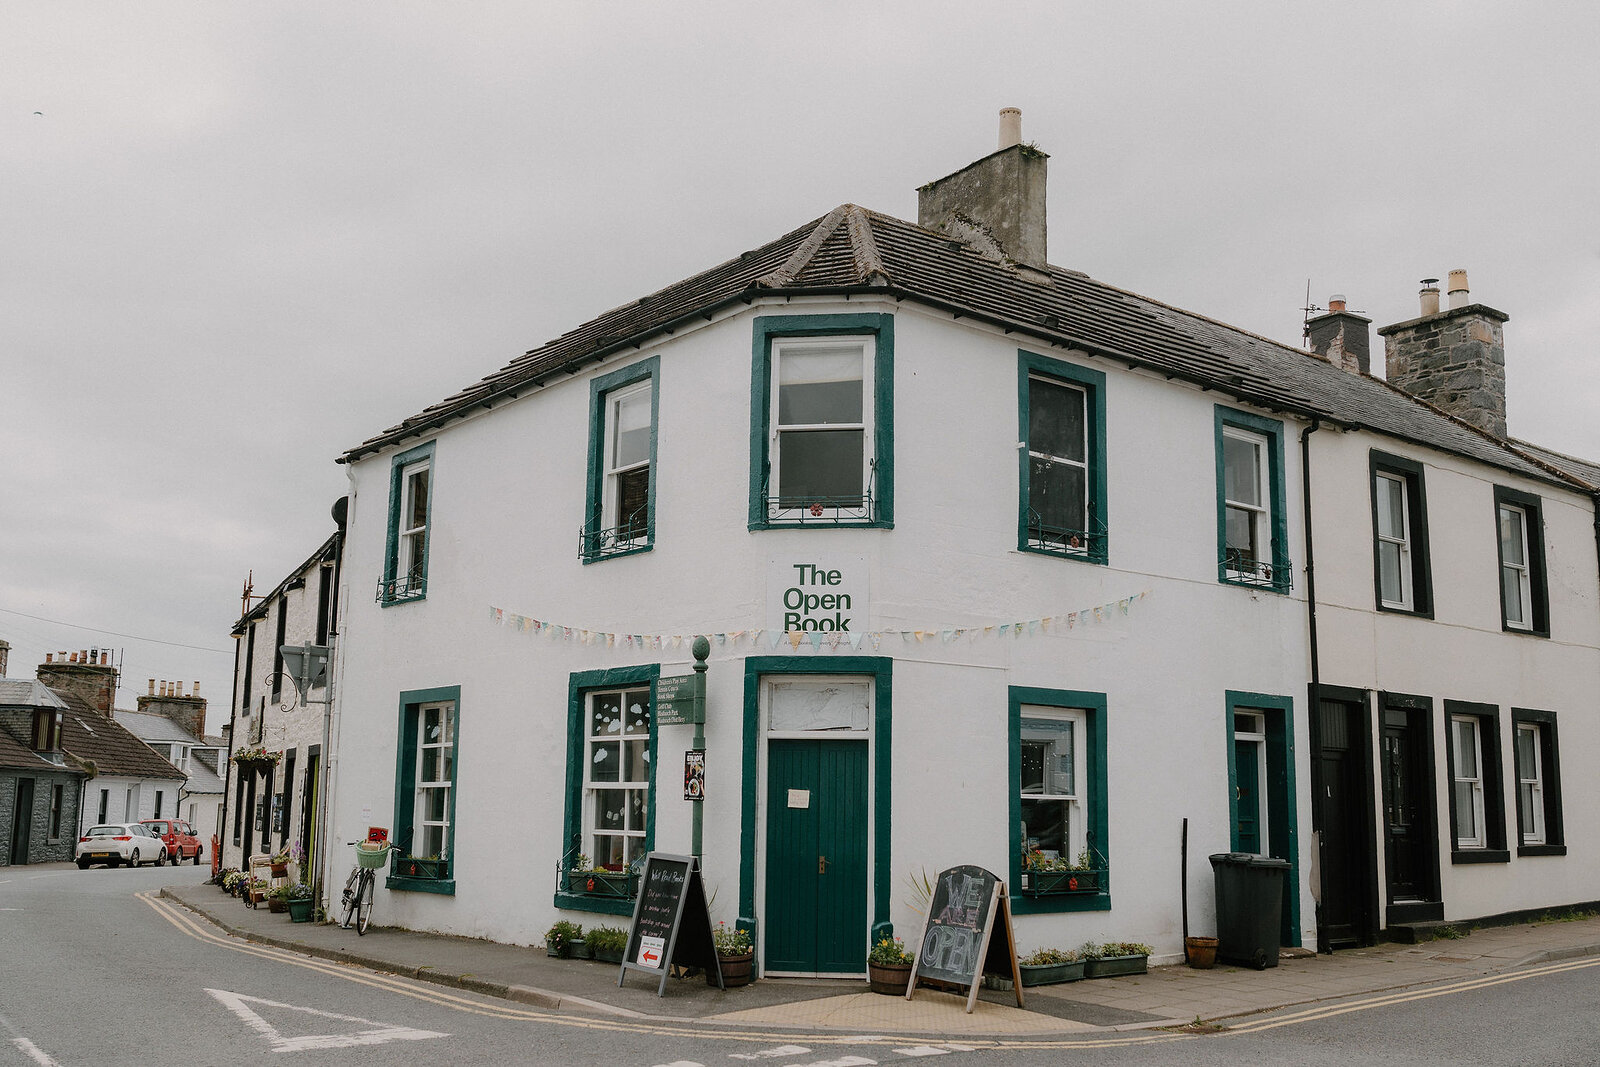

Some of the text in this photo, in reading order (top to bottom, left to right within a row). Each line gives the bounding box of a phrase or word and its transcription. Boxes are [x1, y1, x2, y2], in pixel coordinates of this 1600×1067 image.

[793, 564, 842, 585] The
[783, 587, 851, 615] Open
[784, 612, 851, 634] Book
[652, 869, 684, 883] Well Read Books
[945, 874, 985, 908] WE
[922, 926, 981, 975] OPEN
